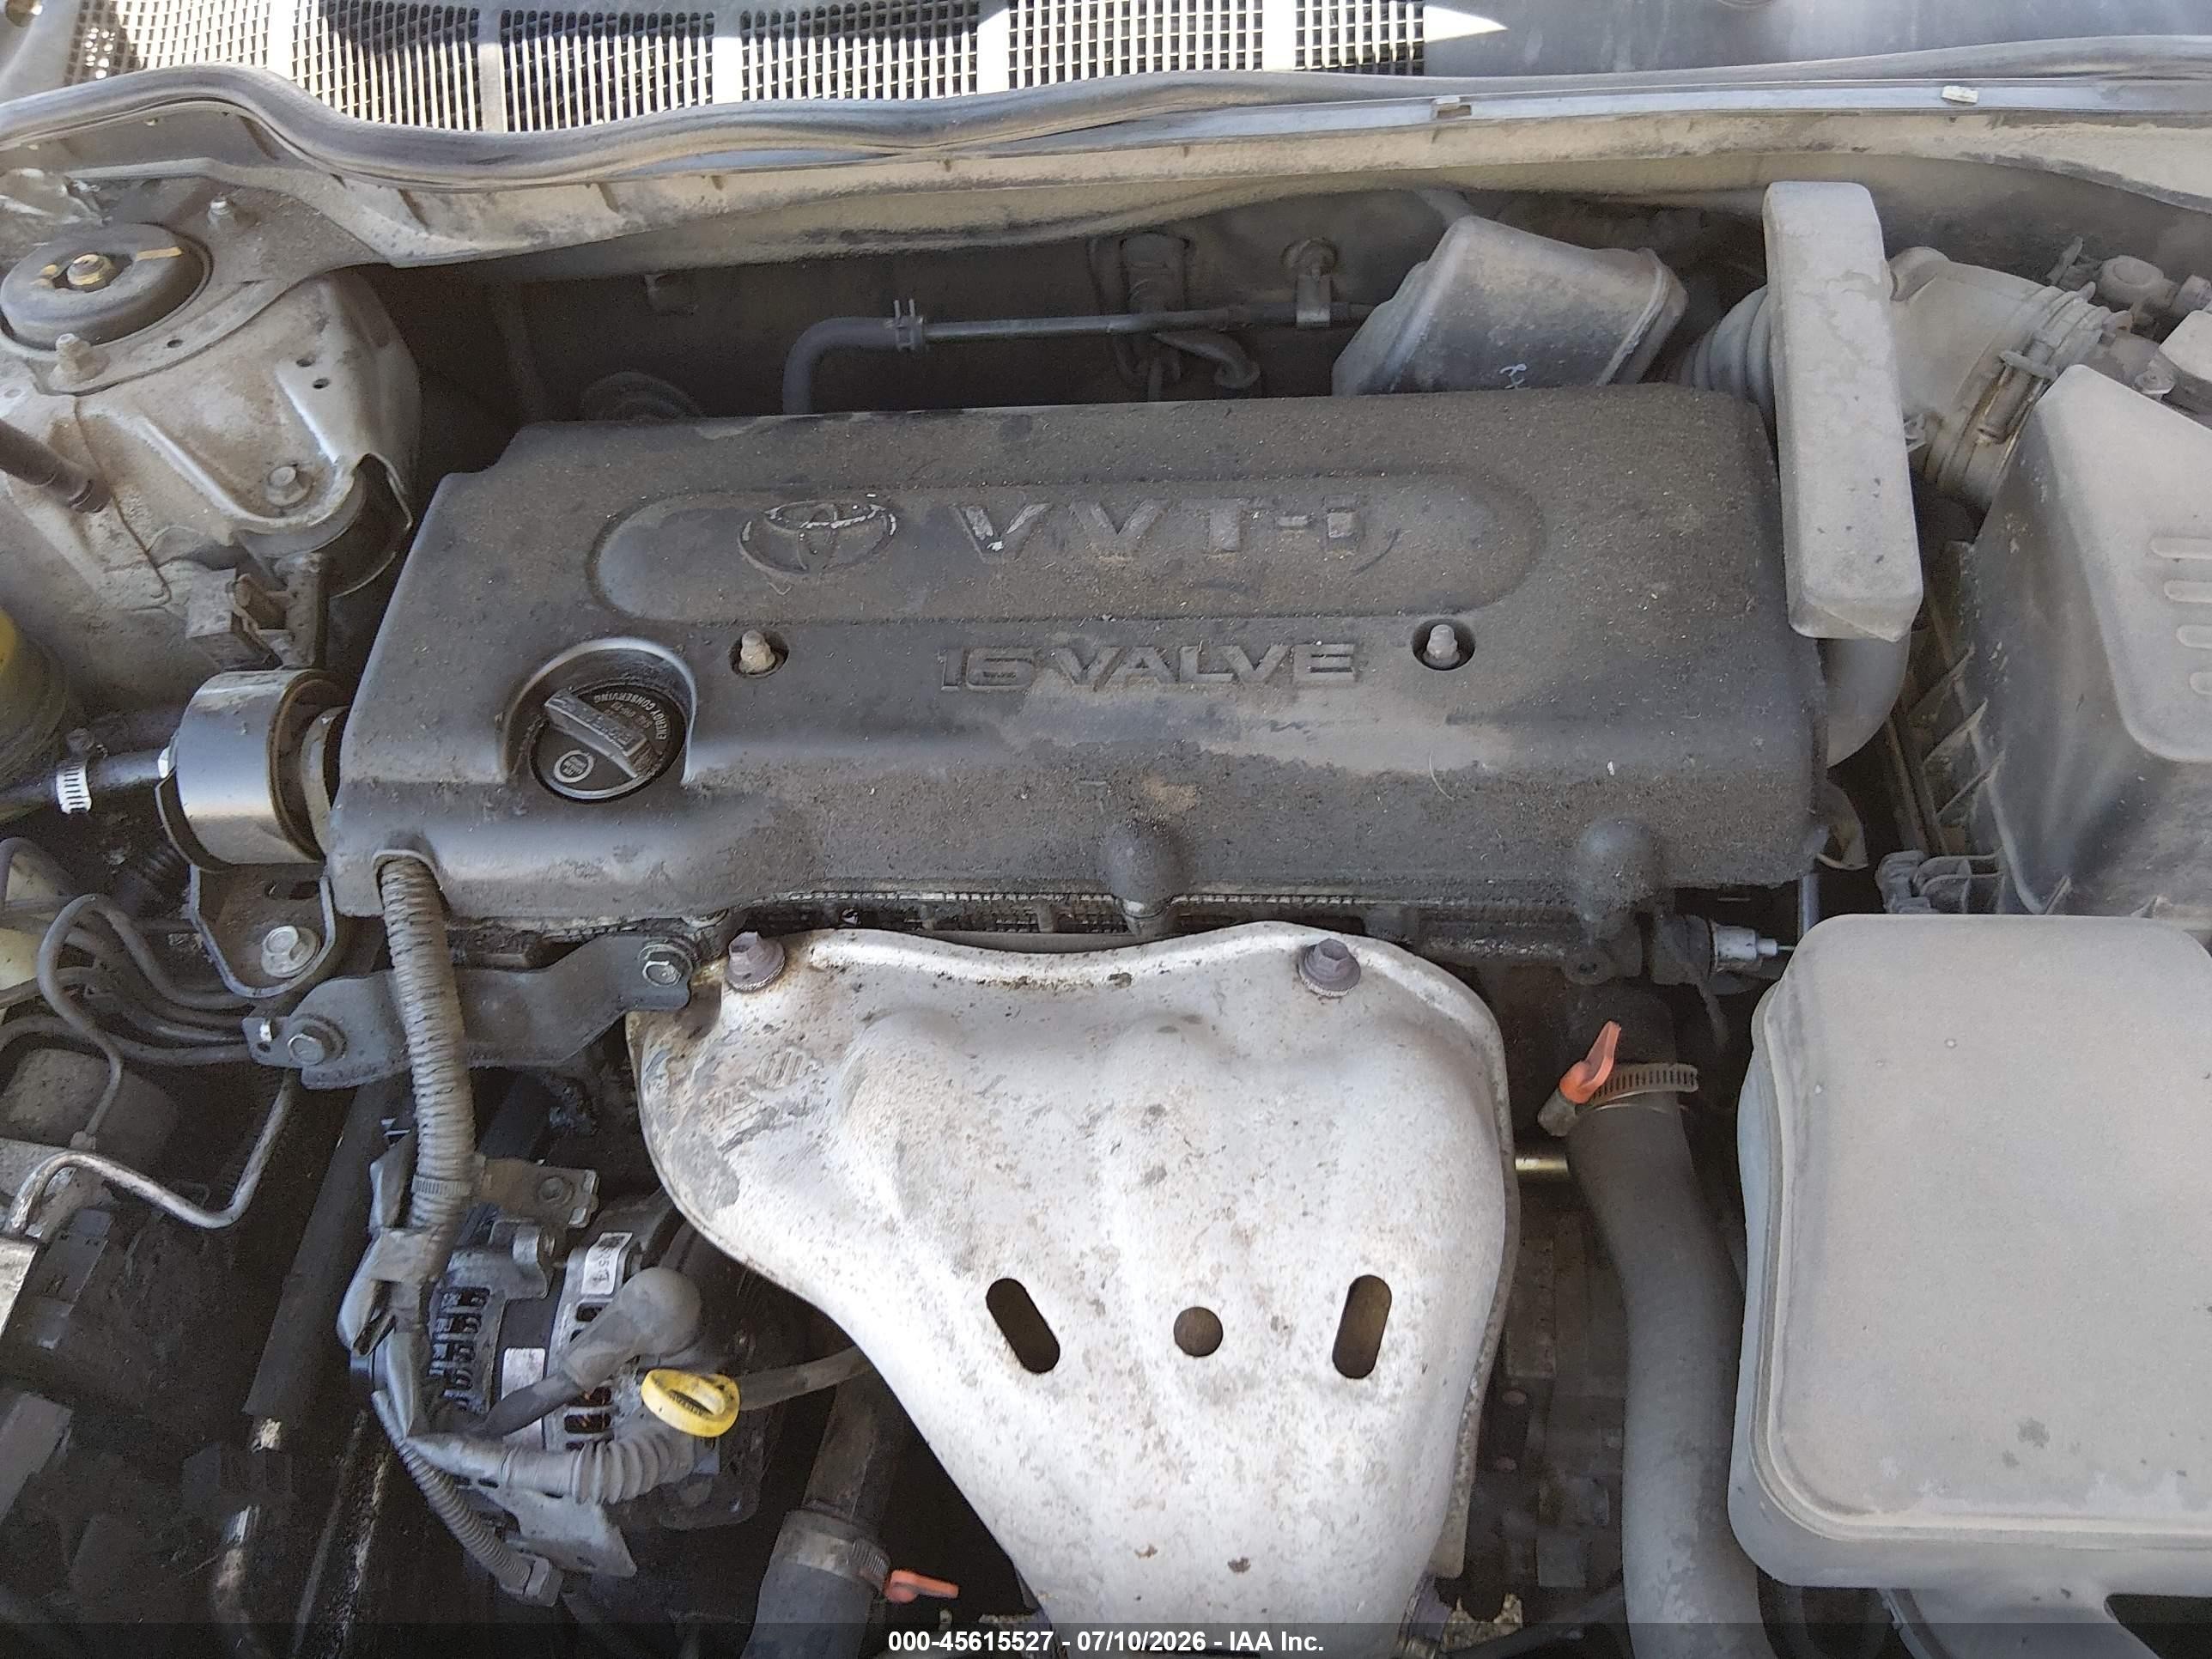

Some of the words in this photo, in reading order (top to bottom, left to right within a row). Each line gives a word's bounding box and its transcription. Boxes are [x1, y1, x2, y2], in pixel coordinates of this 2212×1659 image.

[943, 647, 1033, 689] 16
[1054, 644, 1355, 687] VALVE
[593, 692, 656, 711] CONSERVING
[649, 709, 667, 739] ENERGY
